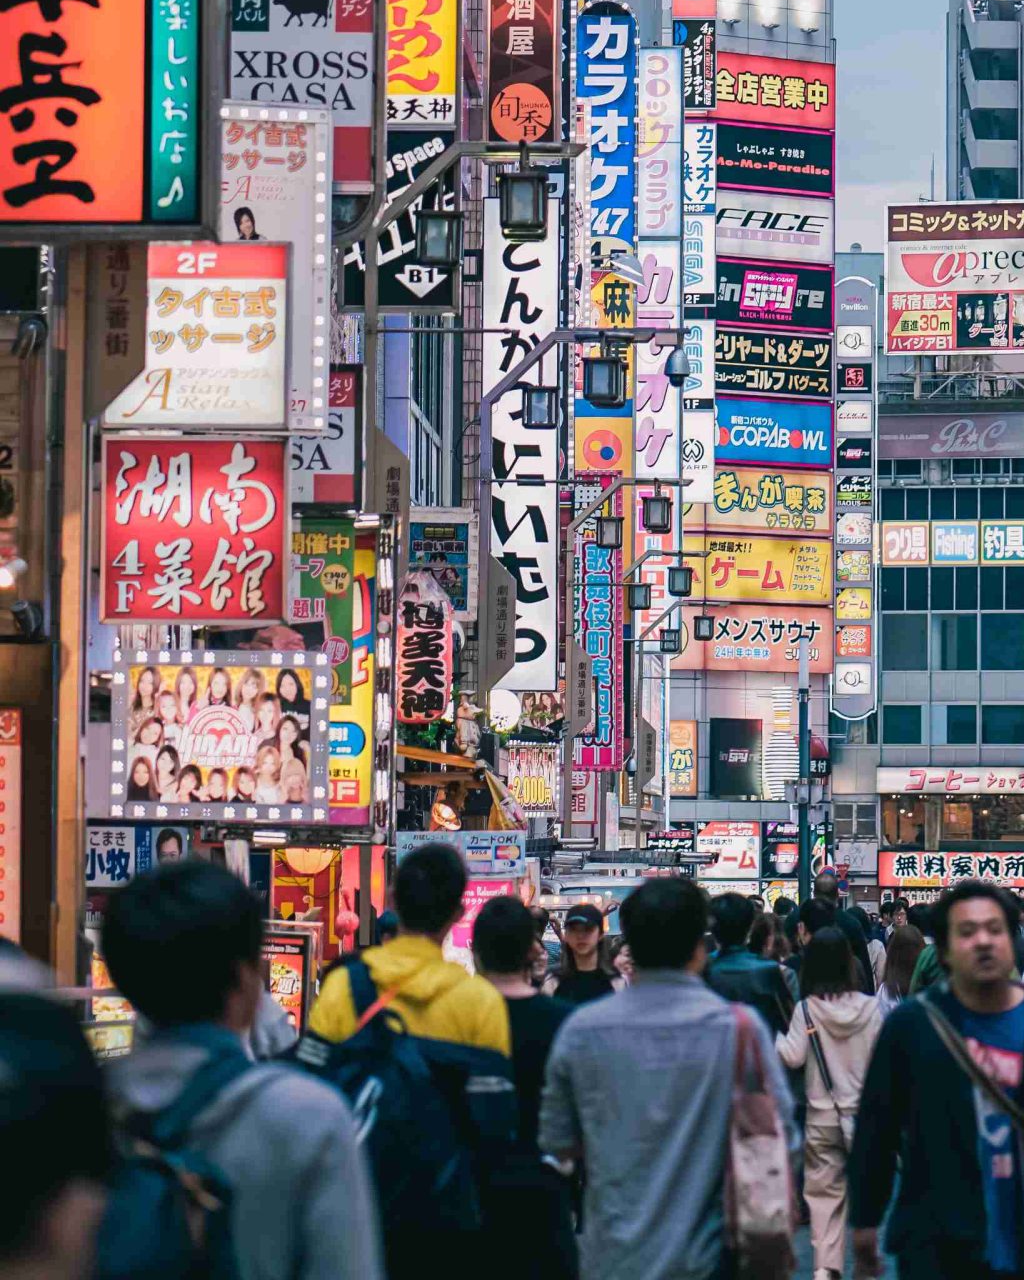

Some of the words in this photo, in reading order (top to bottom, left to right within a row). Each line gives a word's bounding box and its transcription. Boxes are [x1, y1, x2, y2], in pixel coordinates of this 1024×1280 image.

[236, 9, 266, 22] バル
[341, 5, 369, 17] アン
[700, 22, 715, 35] 4F
[234, 50, 369, 79] XROSS
[251, 81, 355, 111] CASA
[717, 67, 829, 112] 全店営業中
[584, 15, 630, 202] カラオケ
[226, 121, 307, 149] タイ古式
[695, 125, 714, 202] カラオケ
[716, 207, 830, 234] FACE
[176, 252, 218, 274] 2F
[683, 220, 703, 288] SEGA
[408, 268, 434, 284] B1
[154, 286, 277, 319] タイ古式
[685, 294, 701, 304] 2F
[892, 293, 953, 311] 新宿最大
[901, 314, 950, 333] 直進30m
[683, 325, 703, 392] SEGA
[746, 368, 785, 391] ゴルフ
[685, 399, 700, 409] 1F
[114, 441, 277, 535] 湖南
[714, 470, 826, 515] まんが喫茶
[885, 526, 927, 560] つり具
[934, 527, 975, 561] Fishing
[984, 526, 1024, 560] 釣具
[111, 539, 145, 613] 4F
[147, 536, 275, 616] 菜館
[711, 556, 785, 590] ゲーム
[715, 617, 821, 644] メンズサウナ
[904, 769, 980, 792] コーヒー
[89, 830, 127, 847] こまき
[85, 848, 132, 882] 小牧
